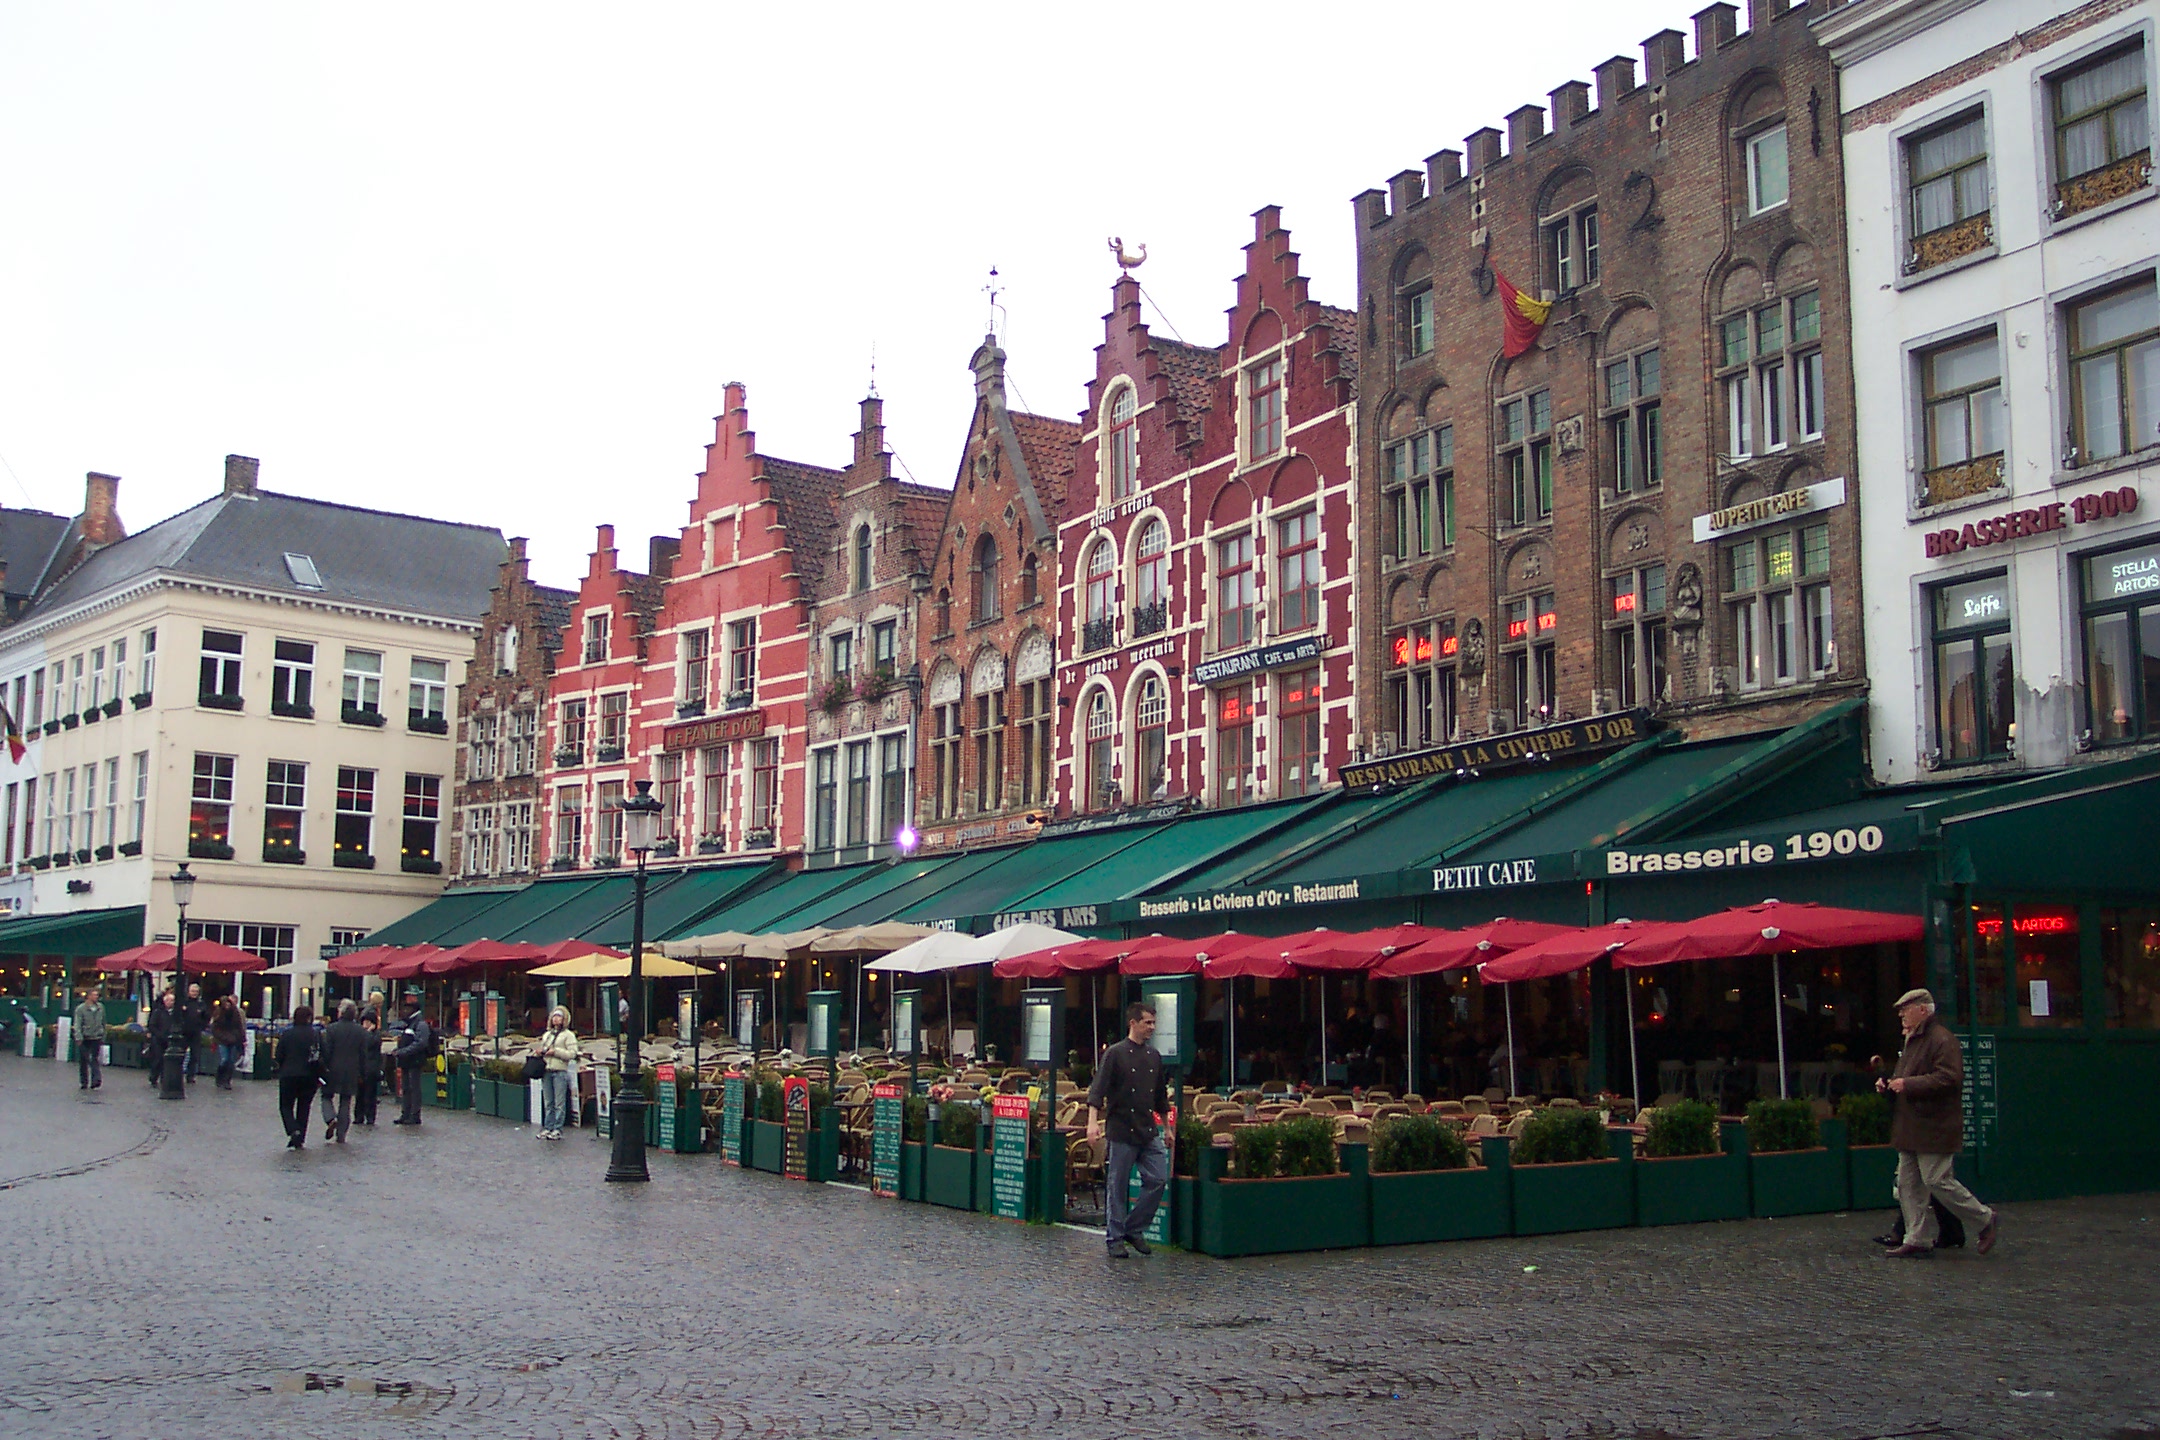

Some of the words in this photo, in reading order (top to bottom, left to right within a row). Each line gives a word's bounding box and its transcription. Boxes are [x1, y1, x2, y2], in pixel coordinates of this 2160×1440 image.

[1709, 510, 1728, 531] AU
[1728, 500, 1770, 526] PETIT
[1770, 488, 1809, 514] CAFE
[1925, 502, 2067, 558] BRASSERIE
[2070, 486, 2139, 524] 1900
[2112, 557, 2159, 578] STELLA
[2113, 573, 2160, 594] ARTOIS
[1964, 594, 2001, 618] Leffe
[1196, 652, 1261, 682] RESTAURANT
[1264, 651, 1284, 665] CAFE
[668, 733, 684, 747] LE
[685, 720, 729, 745] PANIER
[1345, 753, 1454, 788] RESTAURANT
[1463, 745, 1491, 766] LA
[1496, 729, 1576, 758] CIVIERE
[1585, 717, 1637, 743] D'OR
[1607, 840, 1775, 875] Brasserie
[1786, 825, 1884, 860] 1900
[1432, 865, 1483, 891] PETIT
[1488, 859, 1537, 885] CAFE
[1140, 896, 1189, 917] Brasserie
[1198, 896, 1212, 912] La
[1213, 891, 1254, 910] Civiere
[1256, 889, 1283, 907] d'Or
[1293, 879, 1359, 903] Restaurant
[1062, 904, 1098, 928] ARTS
[2021, 917, 2064, 931] ARTOIS
